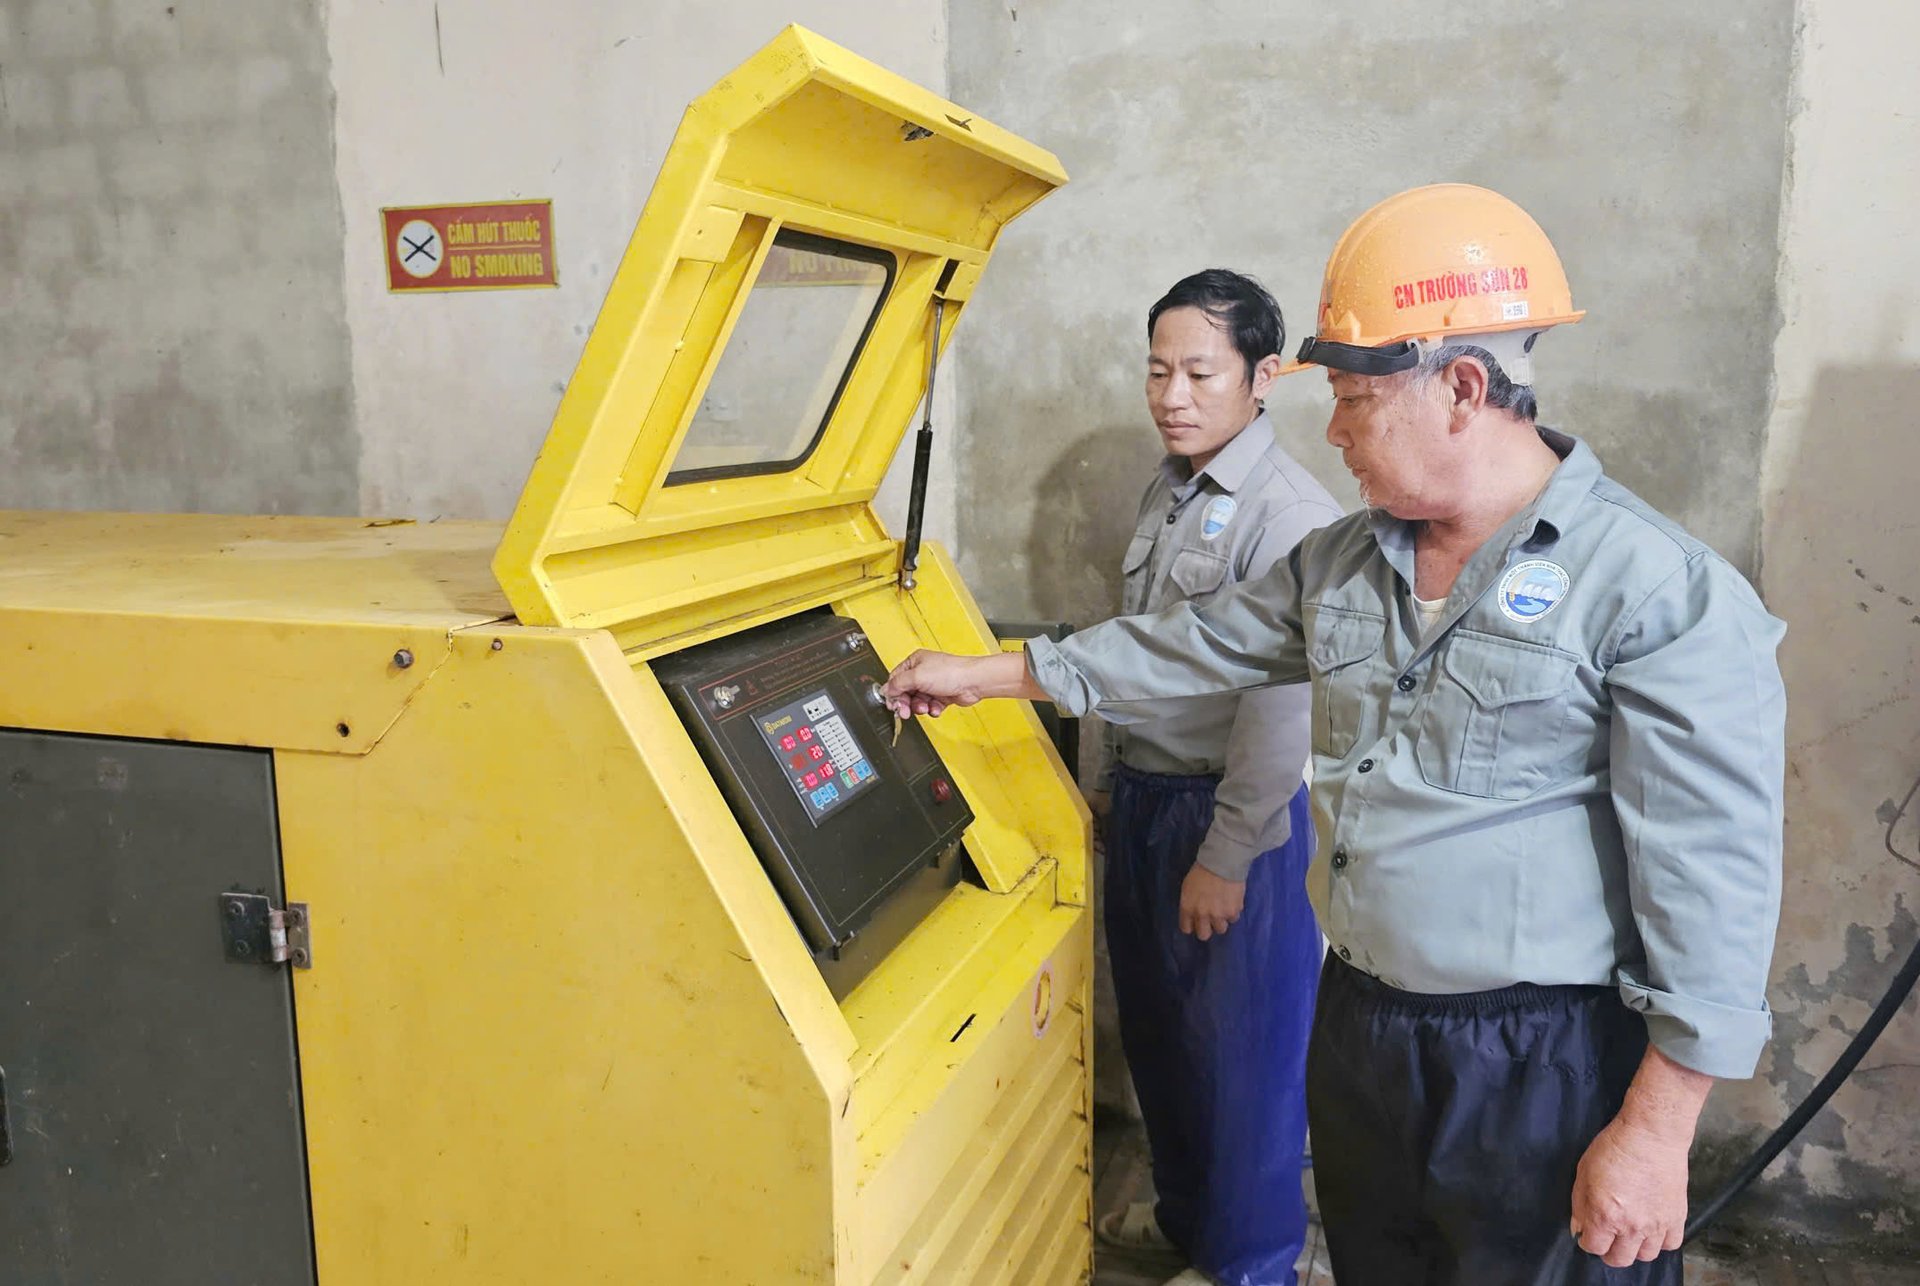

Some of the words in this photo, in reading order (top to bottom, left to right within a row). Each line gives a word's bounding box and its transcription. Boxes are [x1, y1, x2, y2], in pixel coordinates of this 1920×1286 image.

[448, 216, 474, 244] CẤM
[476, 217, 499, 243] HÚT
[502, 213, 541, 242] THUỐC
[450, 255, 471, 278] NO
[475, 252, 544, 277] SMOKING
[1394, 282, 1415, 309] CN
[1417, 270, 1477, 304] TRƯỜNG
[1512, 266, 1528, 290] 28
